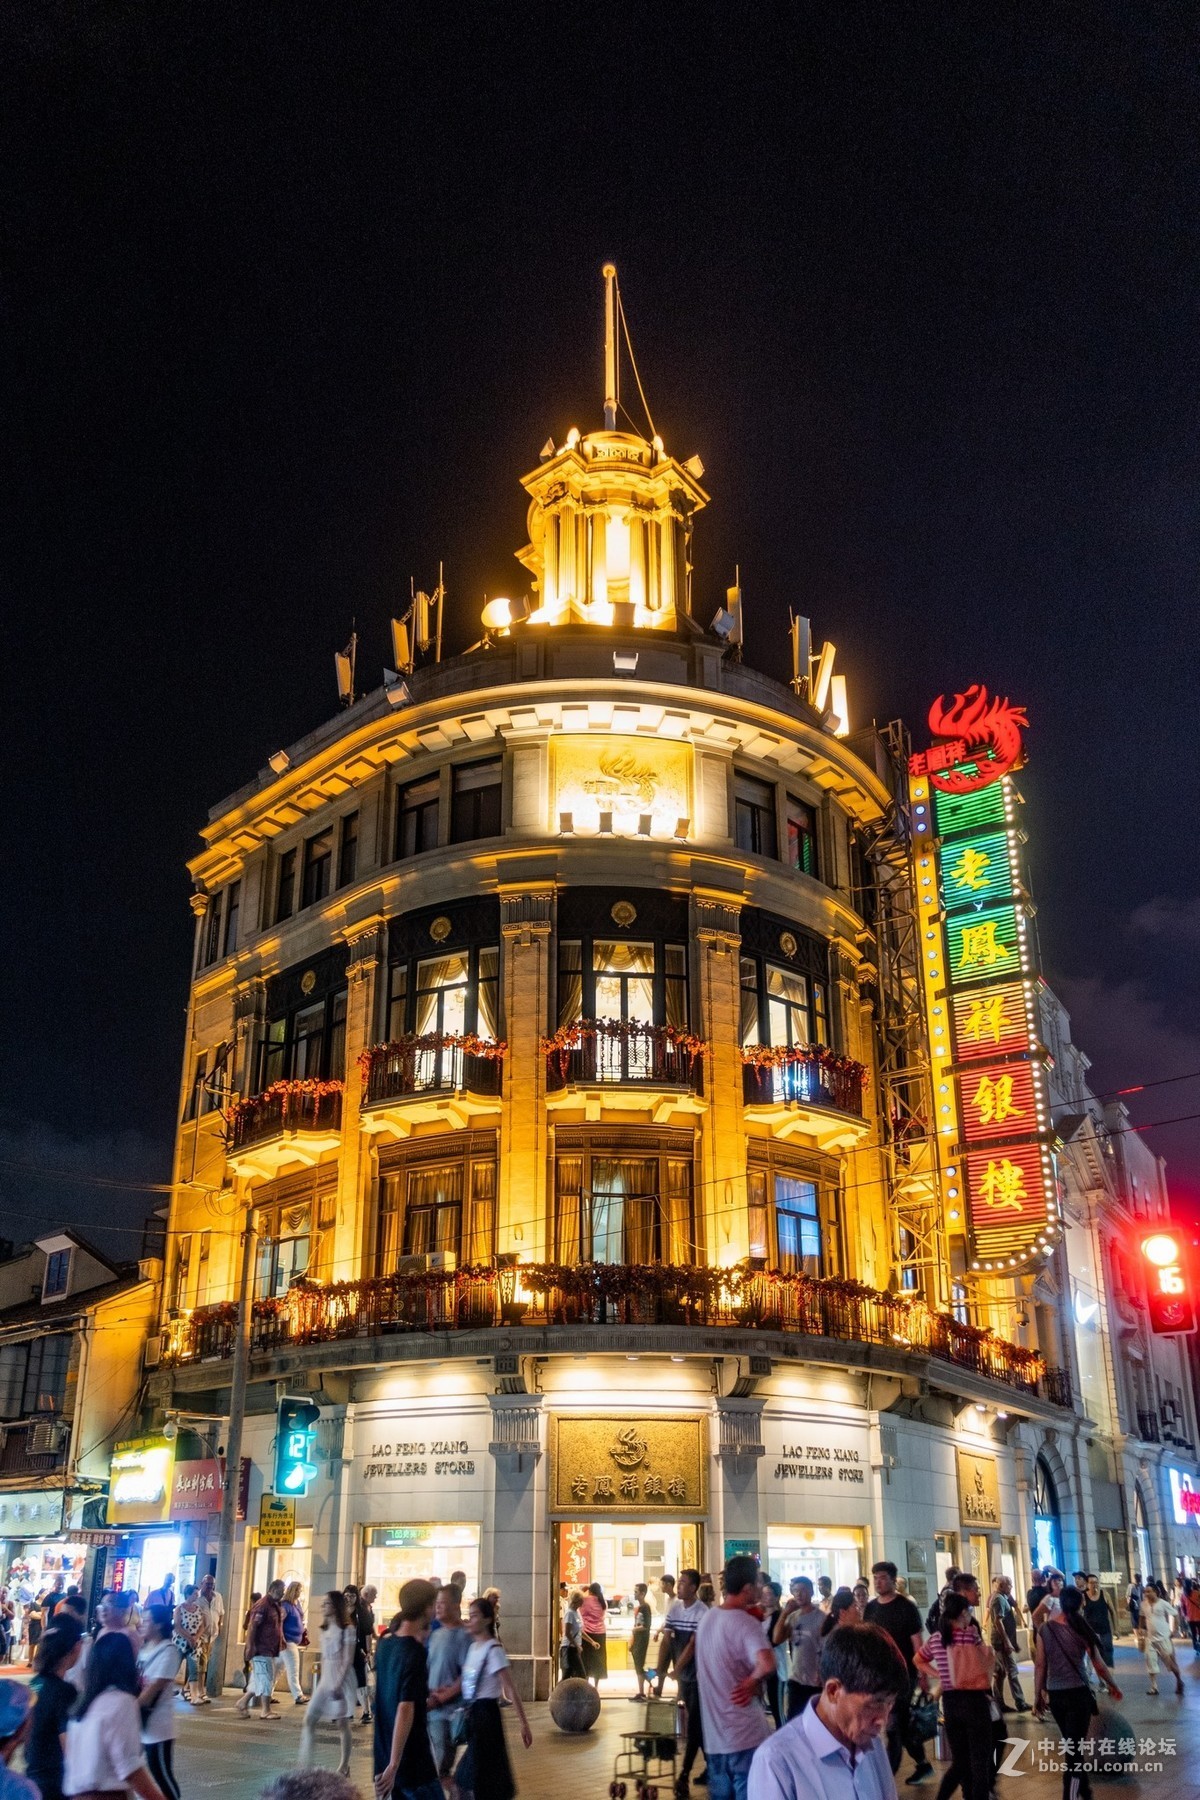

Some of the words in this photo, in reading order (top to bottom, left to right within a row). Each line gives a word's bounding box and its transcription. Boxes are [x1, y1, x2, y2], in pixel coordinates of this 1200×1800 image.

[289, 1434, 305, 1458] 12
[371, 1444, 392, 1458] LAO
[396, 1442, 426, 1456] FENG
[430, 1440, 469, 1455] XIANG
[782, 1444, 803, 1459] LAO
[806, 1446, 830, 1460] FENG
[833, 1448, 859, 1463] XIANG
[364, 1462, 428, 1479] JEWELLERS
[435, 1460, 475, 1475] STORE
[774, 1463, 833, 1480] JEWELLERS
[838, 1467, 864, 1483] STORE
